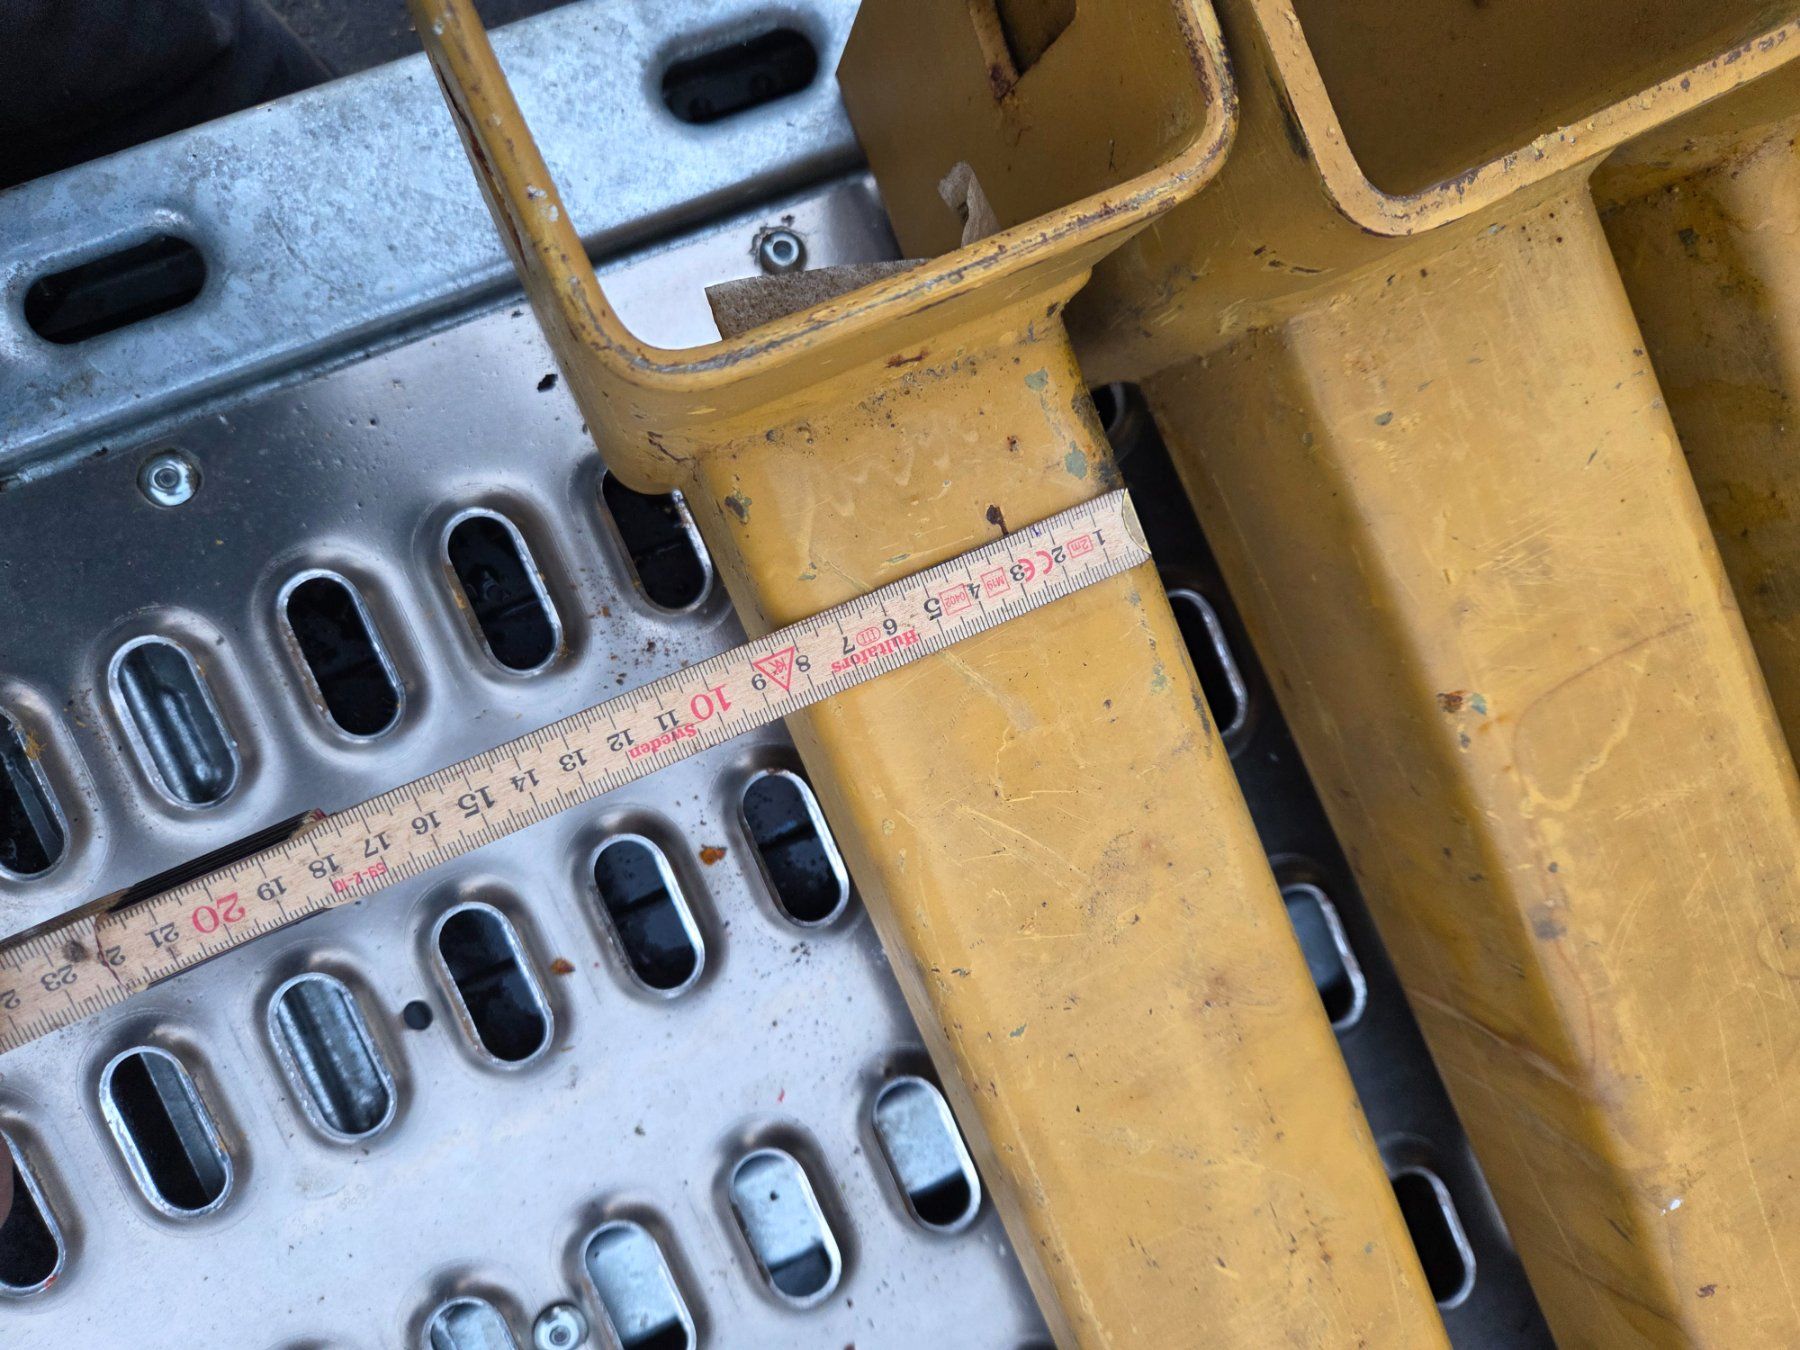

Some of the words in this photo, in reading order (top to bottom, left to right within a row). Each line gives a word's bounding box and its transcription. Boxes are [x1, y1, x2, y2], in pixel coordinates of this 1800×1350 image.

[1070, 539, 1090, 553] 2m
[1092, 529, 1107, 547] 1
[1017, 550, 1054, 582] CE
[1051, 545, 1066, 564] 2
[1009, 564, 1025, 582] 3
[944, 592, 967, 606] 0402
[966, 583, 981, 599] 4
[923, 598, 943, 621] 5
[882, 618, 898, 636] 6
[830, 628, 919, 673] Hultafors
[843, 636, 856, 655] 7
[795, 655, 811, 672] 8
[751, 673, 767, 691] 9
[690, 684, 732, 721] 10
[654, 709, 679, 731] 11
[606, 728, 634, 752] 12
[628, 722, 698, 760] Sweden
[559, 748, 587, 772] 13
[510, 769, 539, 793] 14
[457, 785, 496, 819] 15
[411, 810, 441, 835] 16
[364, 831, 391, 859] 17
[308, 853, 340, 879] 18
[257, 878, 287, 901] 19
[192, 892, 246, 933] 20
[145, 922, 179, 948] 21
[40, 963, 77, 992] 23
[0, 988, 21, 1010] 2
